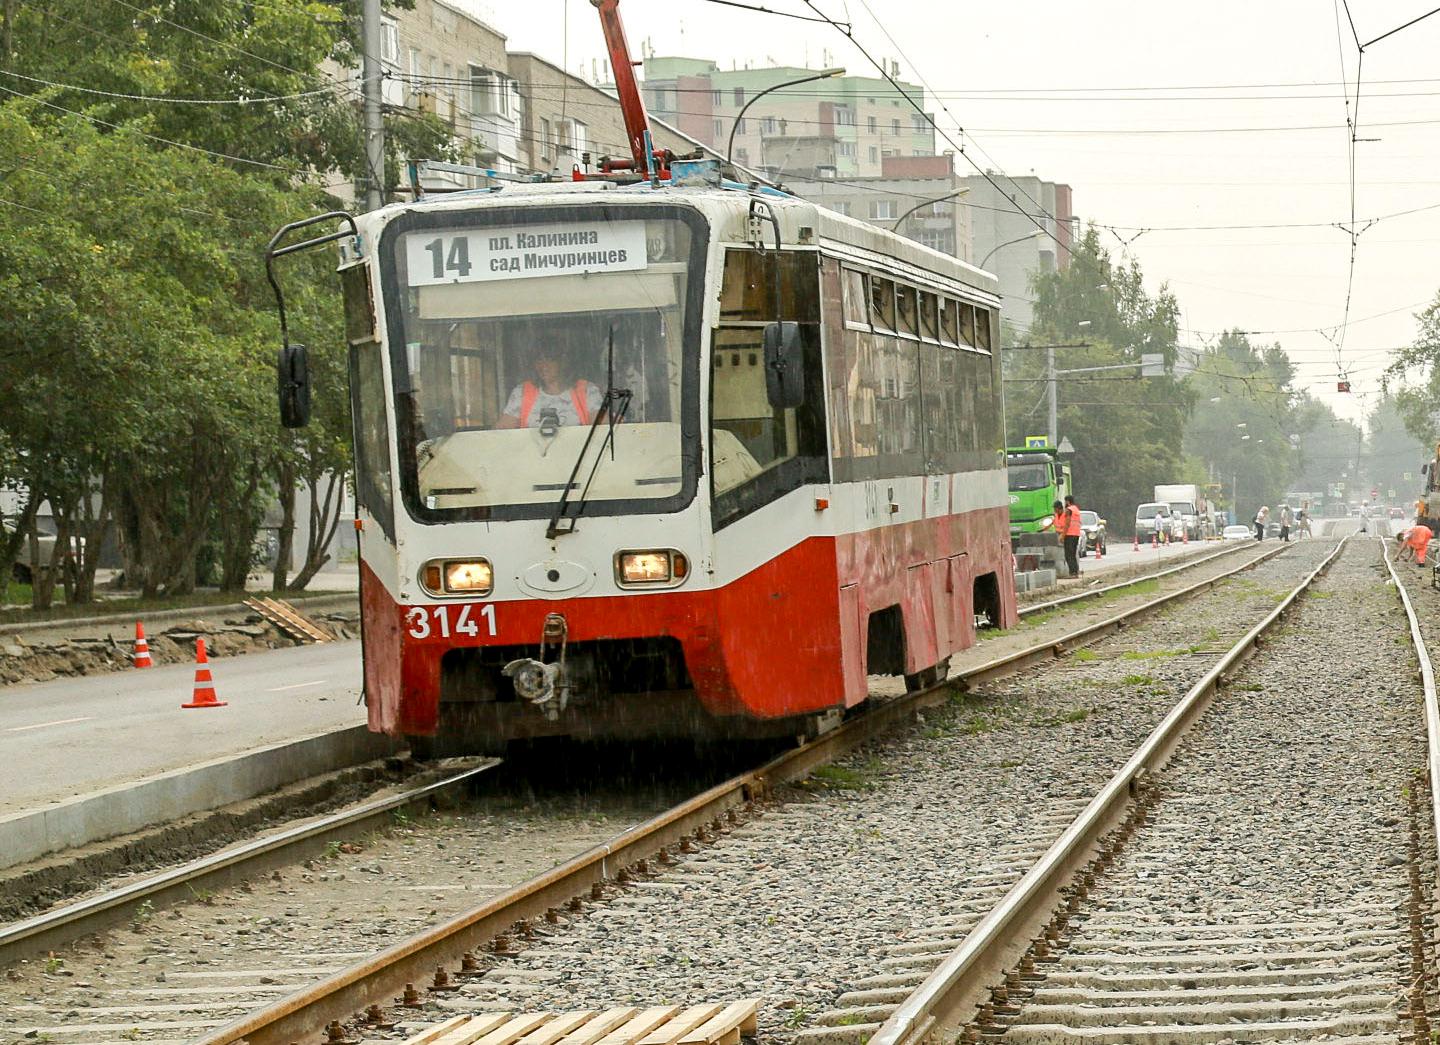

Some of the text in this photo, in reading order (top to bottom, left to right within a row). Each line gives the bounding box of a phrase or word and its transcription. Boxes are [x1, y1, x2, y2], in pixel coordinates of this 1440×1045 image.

[488, 229, 598, 251] пл. Калинина
[425, 236, 472, 278] 14
[489, 248, 628, 273] сад Мичуринцев
[408, 604, 498, 639] 3141
